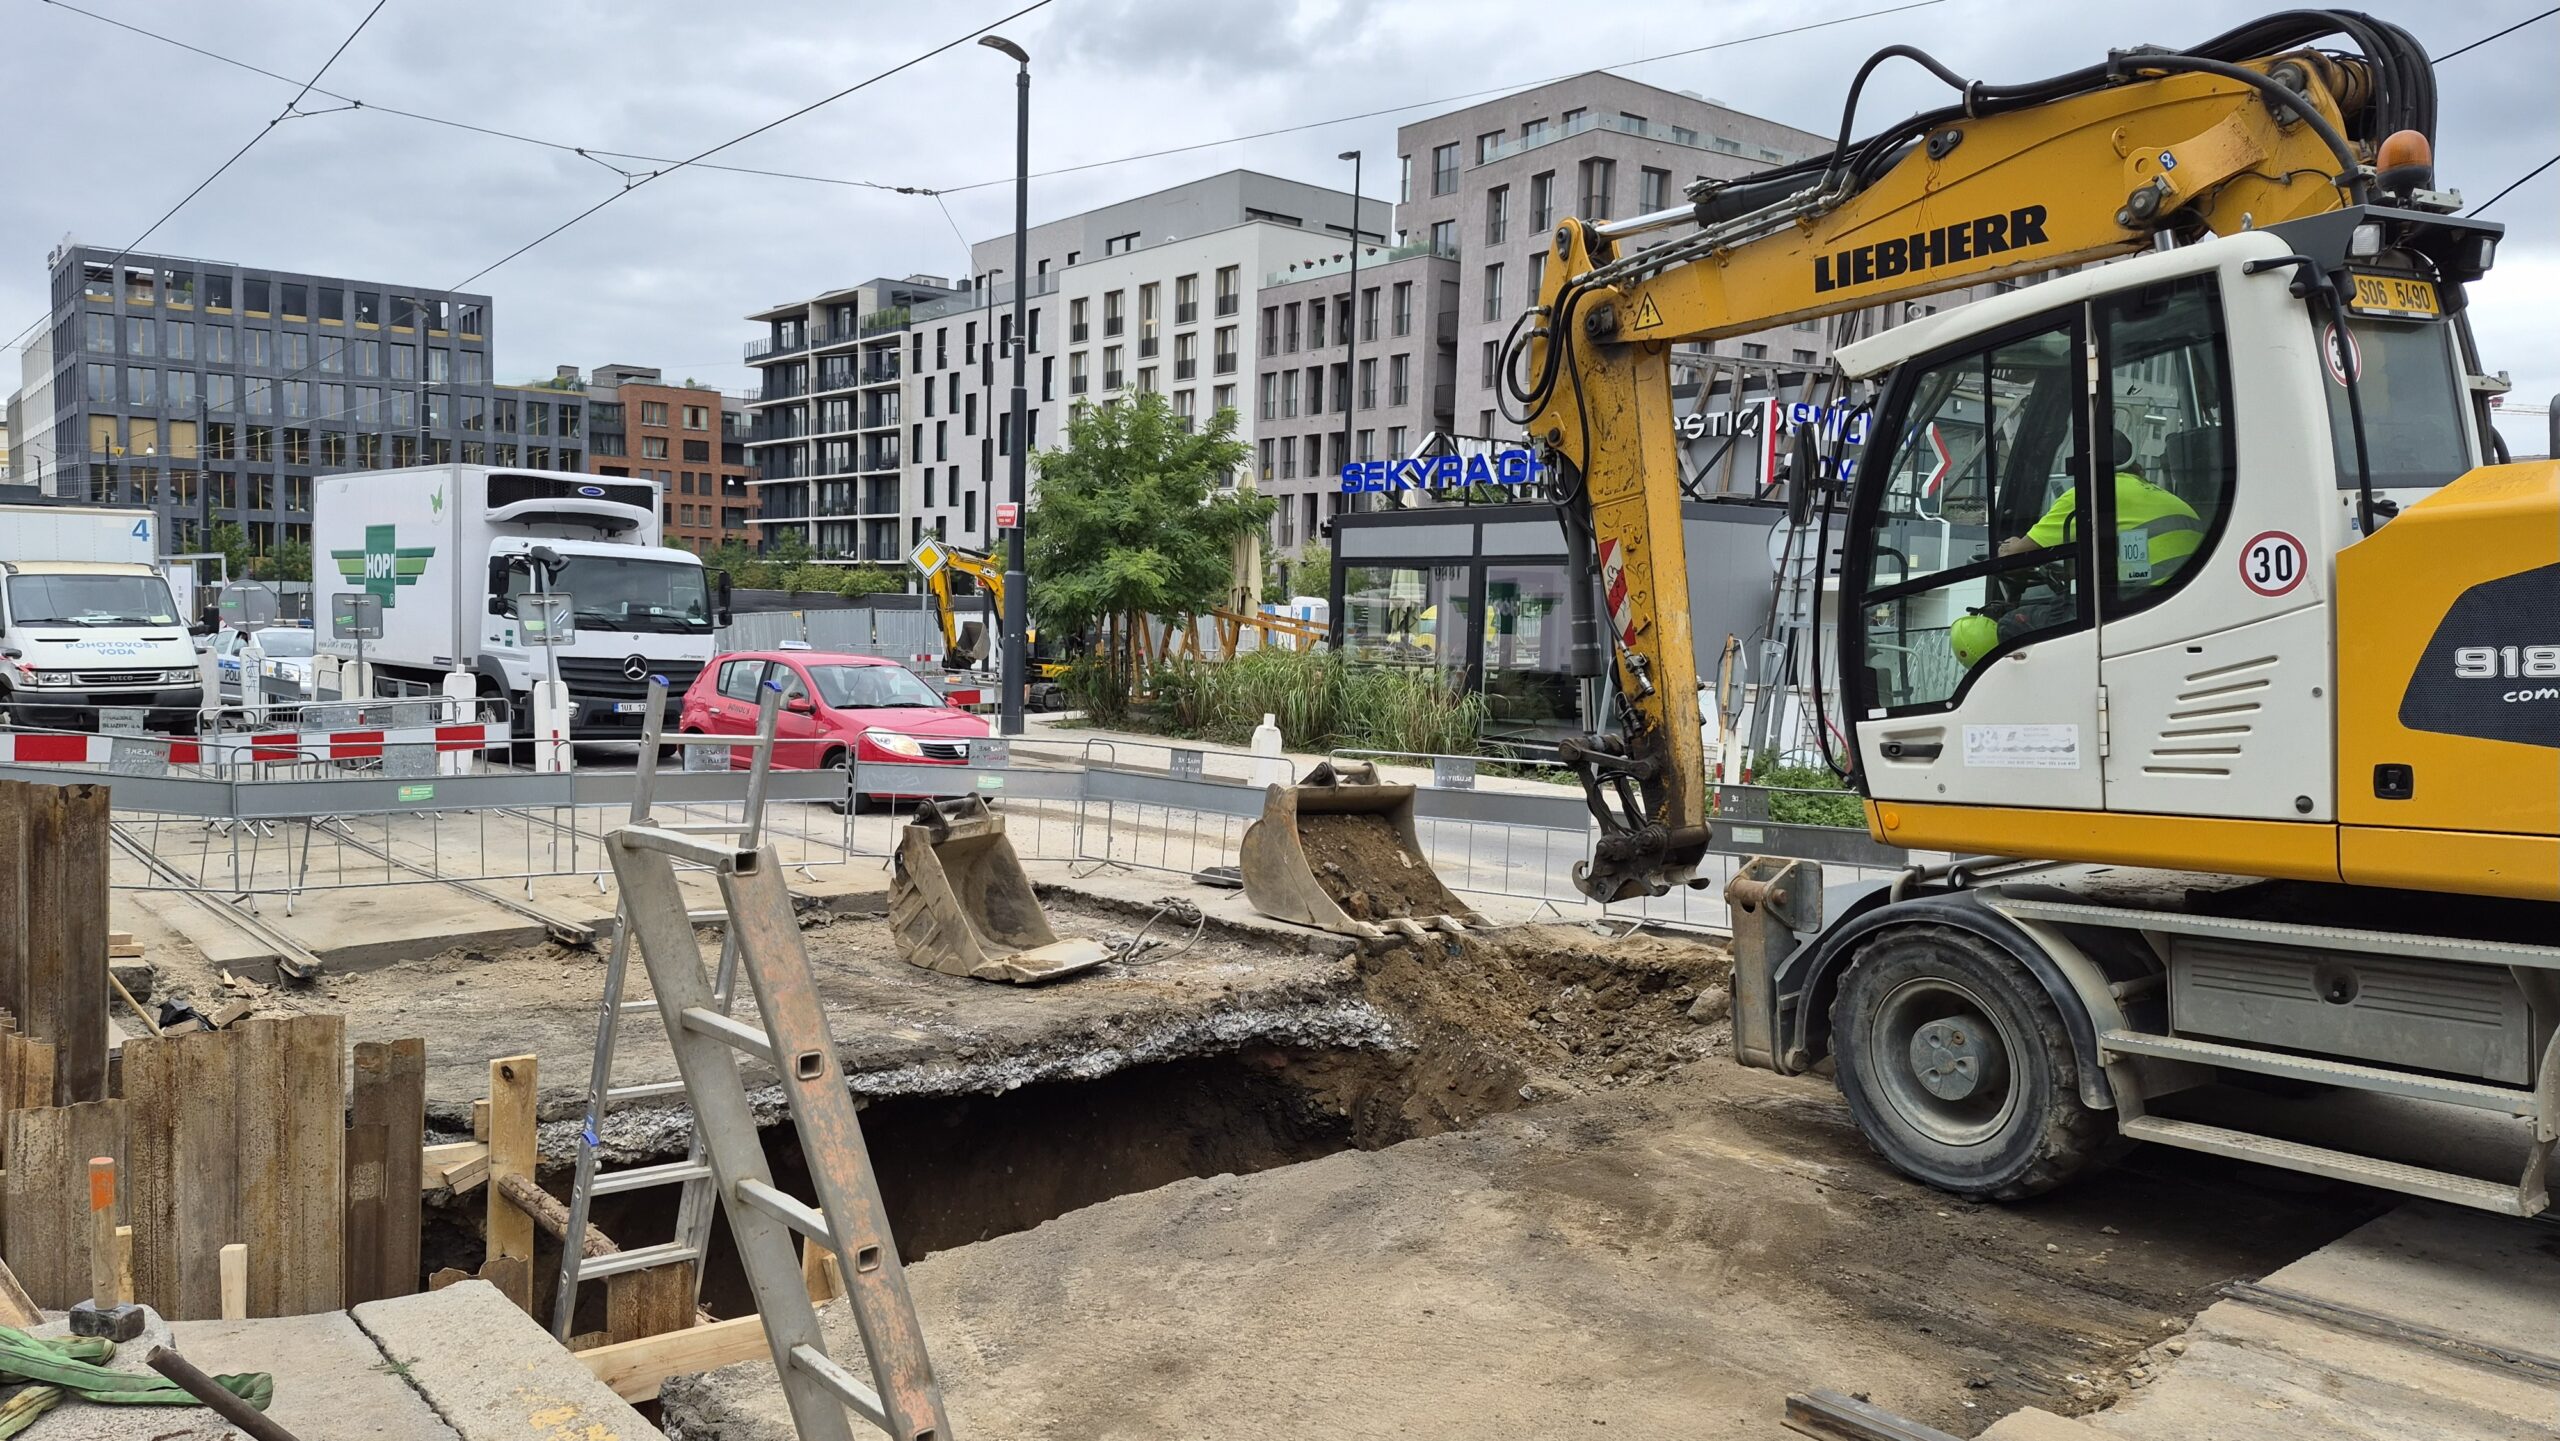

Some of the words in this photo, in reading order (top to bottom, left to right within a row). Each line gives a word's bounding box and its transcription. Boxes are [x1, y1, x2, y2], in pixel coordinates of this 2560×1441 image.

[1814, 204, 2050, 294] LIEBHERR
[2358, 279, 2388, 306] S06
[2394, 282, 2431, 310] 5490
[131, 518, 150, 542] 4
[2123, 543, 2139, 561] 100
[2253, 544, 2293, 584] 30
[366, 552, 395, 579] HOPI
[980, 566, 997, 578] JCB
[65, 641, 159, 649] POHOTOVOST
[97, 648, 136, 656] VODA
[2455, 645, 2560, 678] 918
[2503, 687, 2560, 703] com
